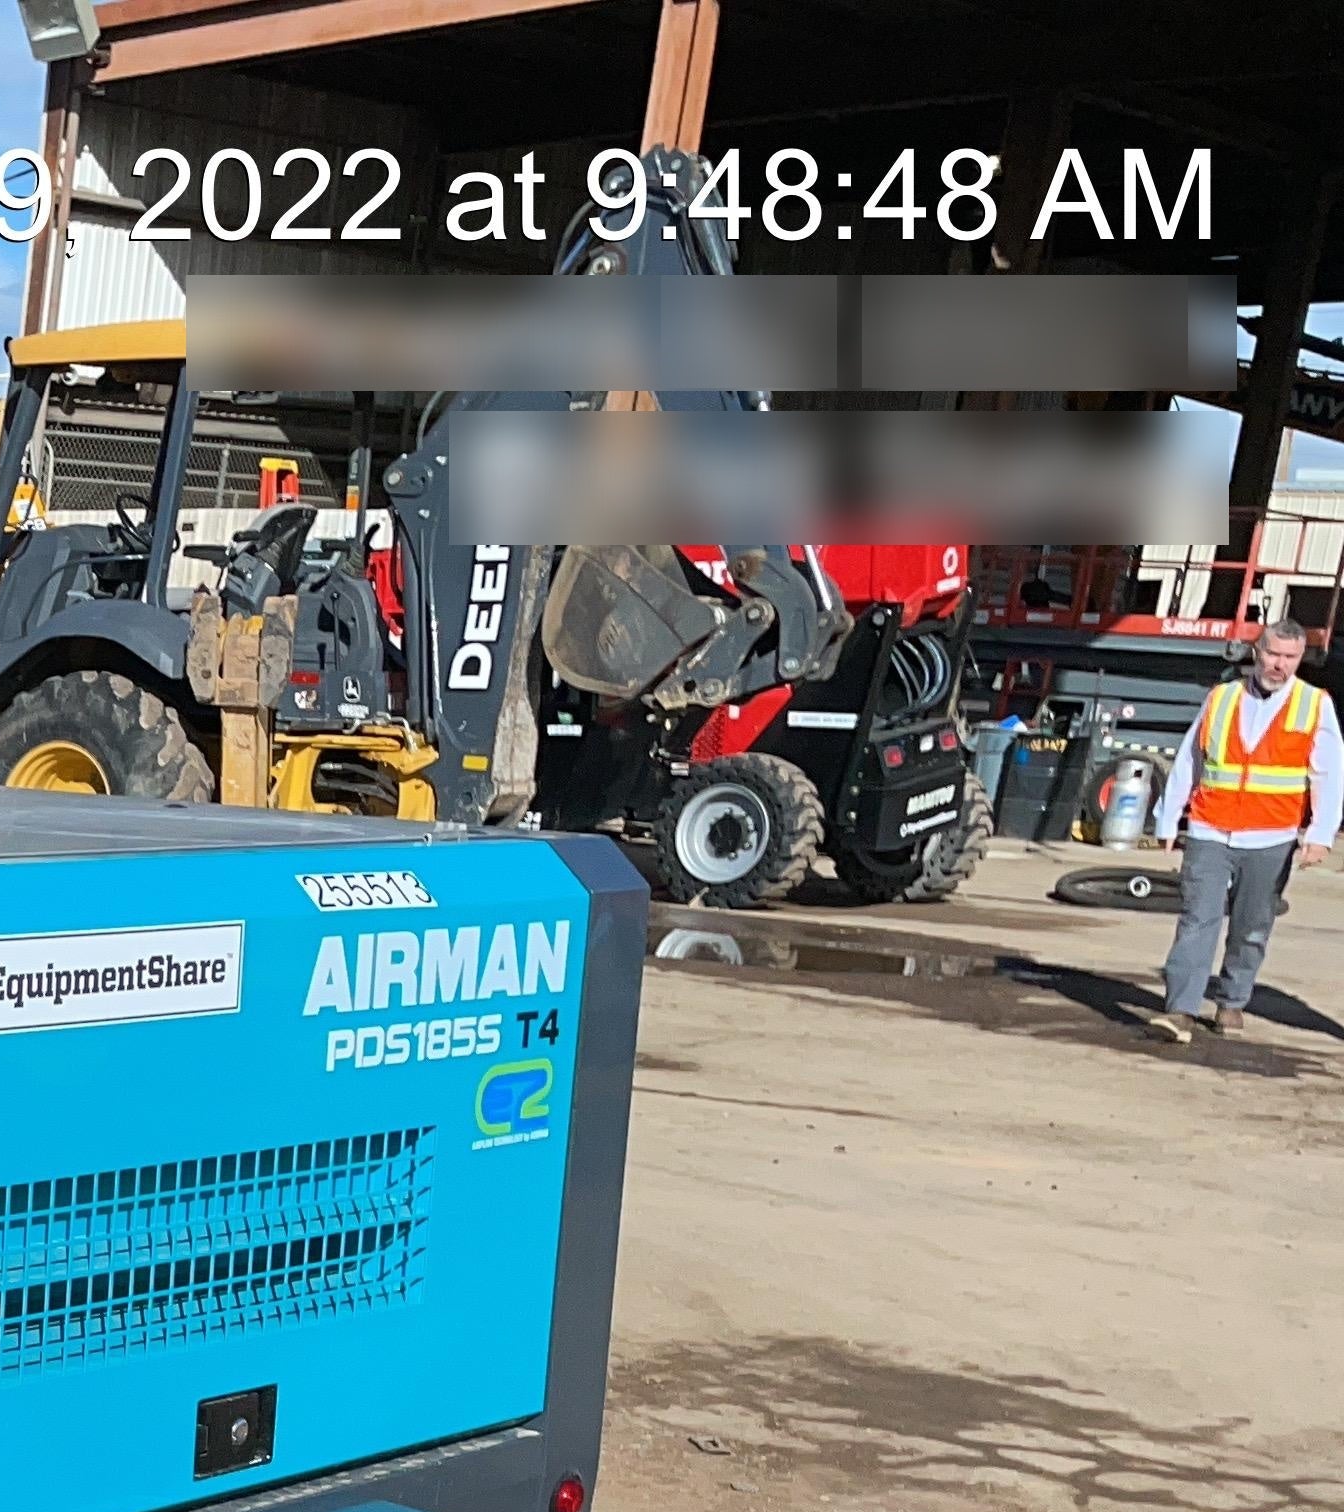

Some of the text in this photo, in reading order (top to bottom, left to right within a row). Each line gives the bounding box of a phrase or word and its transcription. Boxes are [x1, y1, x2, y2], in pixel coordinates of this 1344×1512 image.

[302, 871, 433, 908] 255513
[302, 920, 571, 1017] AIRMAN
[325, 1008, 560, 1072] PDS185S T4
